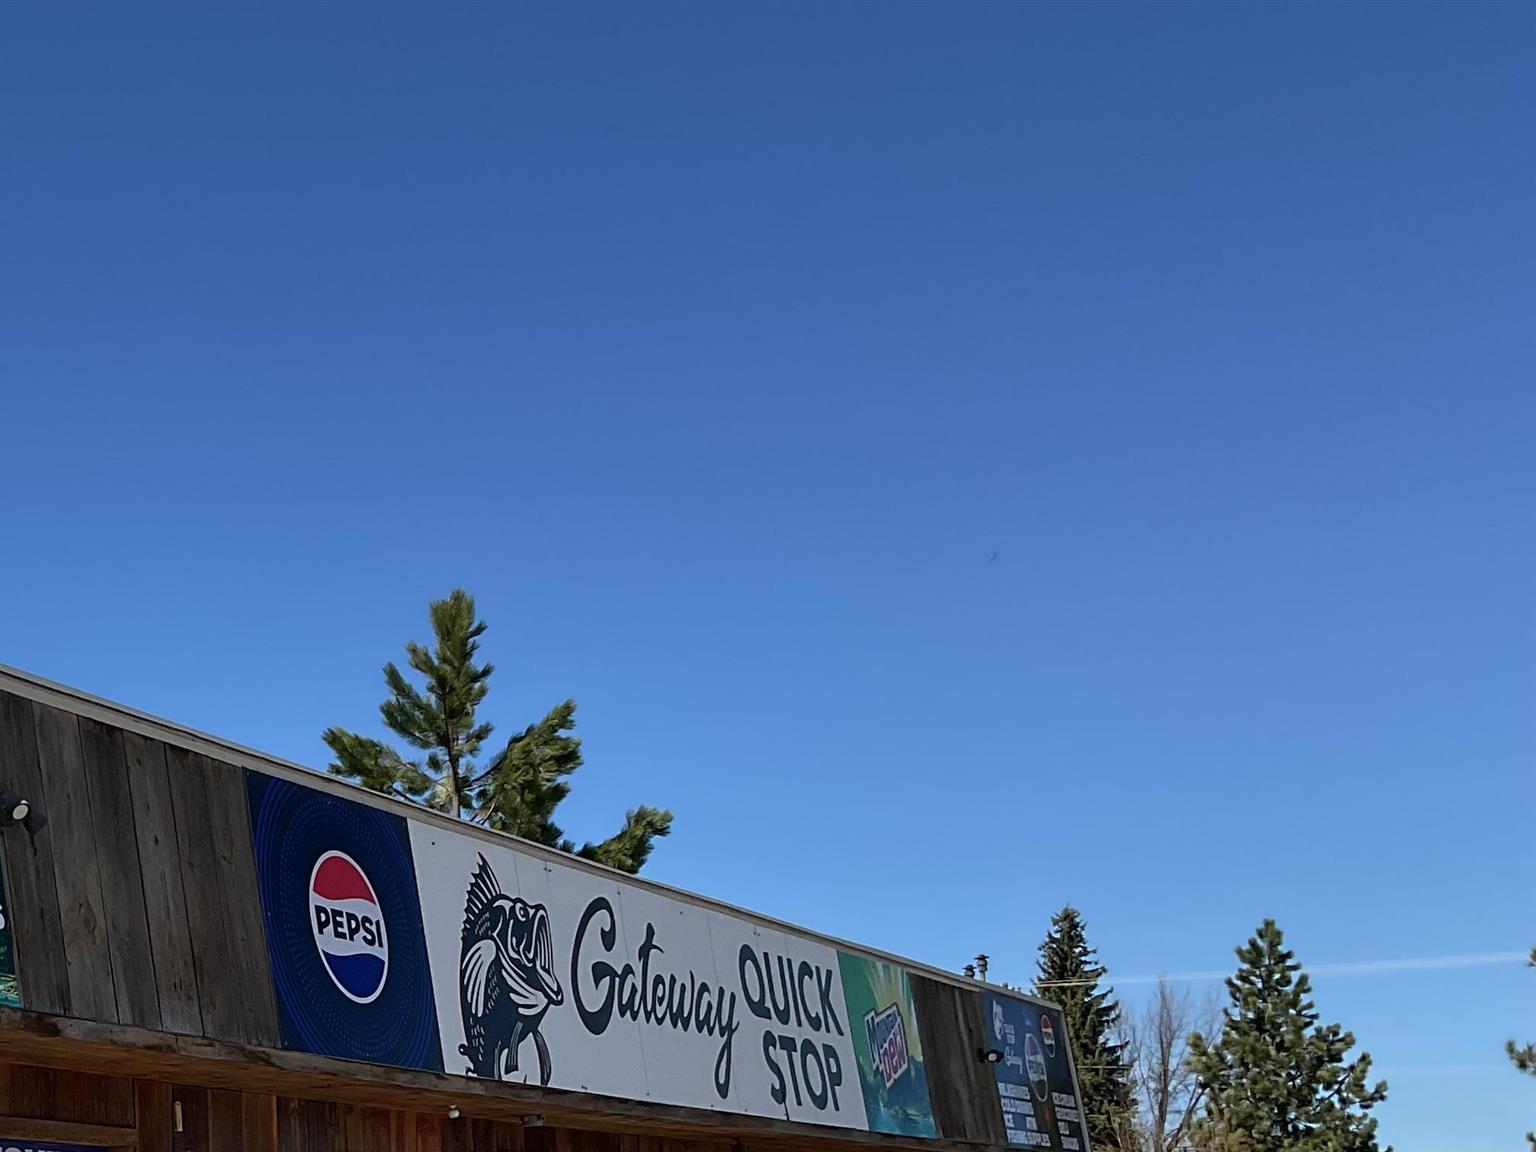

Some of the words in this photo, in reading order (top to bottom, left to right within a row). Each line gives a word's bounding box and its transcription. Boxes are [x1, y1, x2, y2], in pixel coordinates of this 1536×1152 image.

[316, 905, 384, 949] PEPSI
[571, 896, 740, 1099] Gateway
[738, 944, 845, 1037] QUICK
[764, 1029, 842, 1112] STOP
